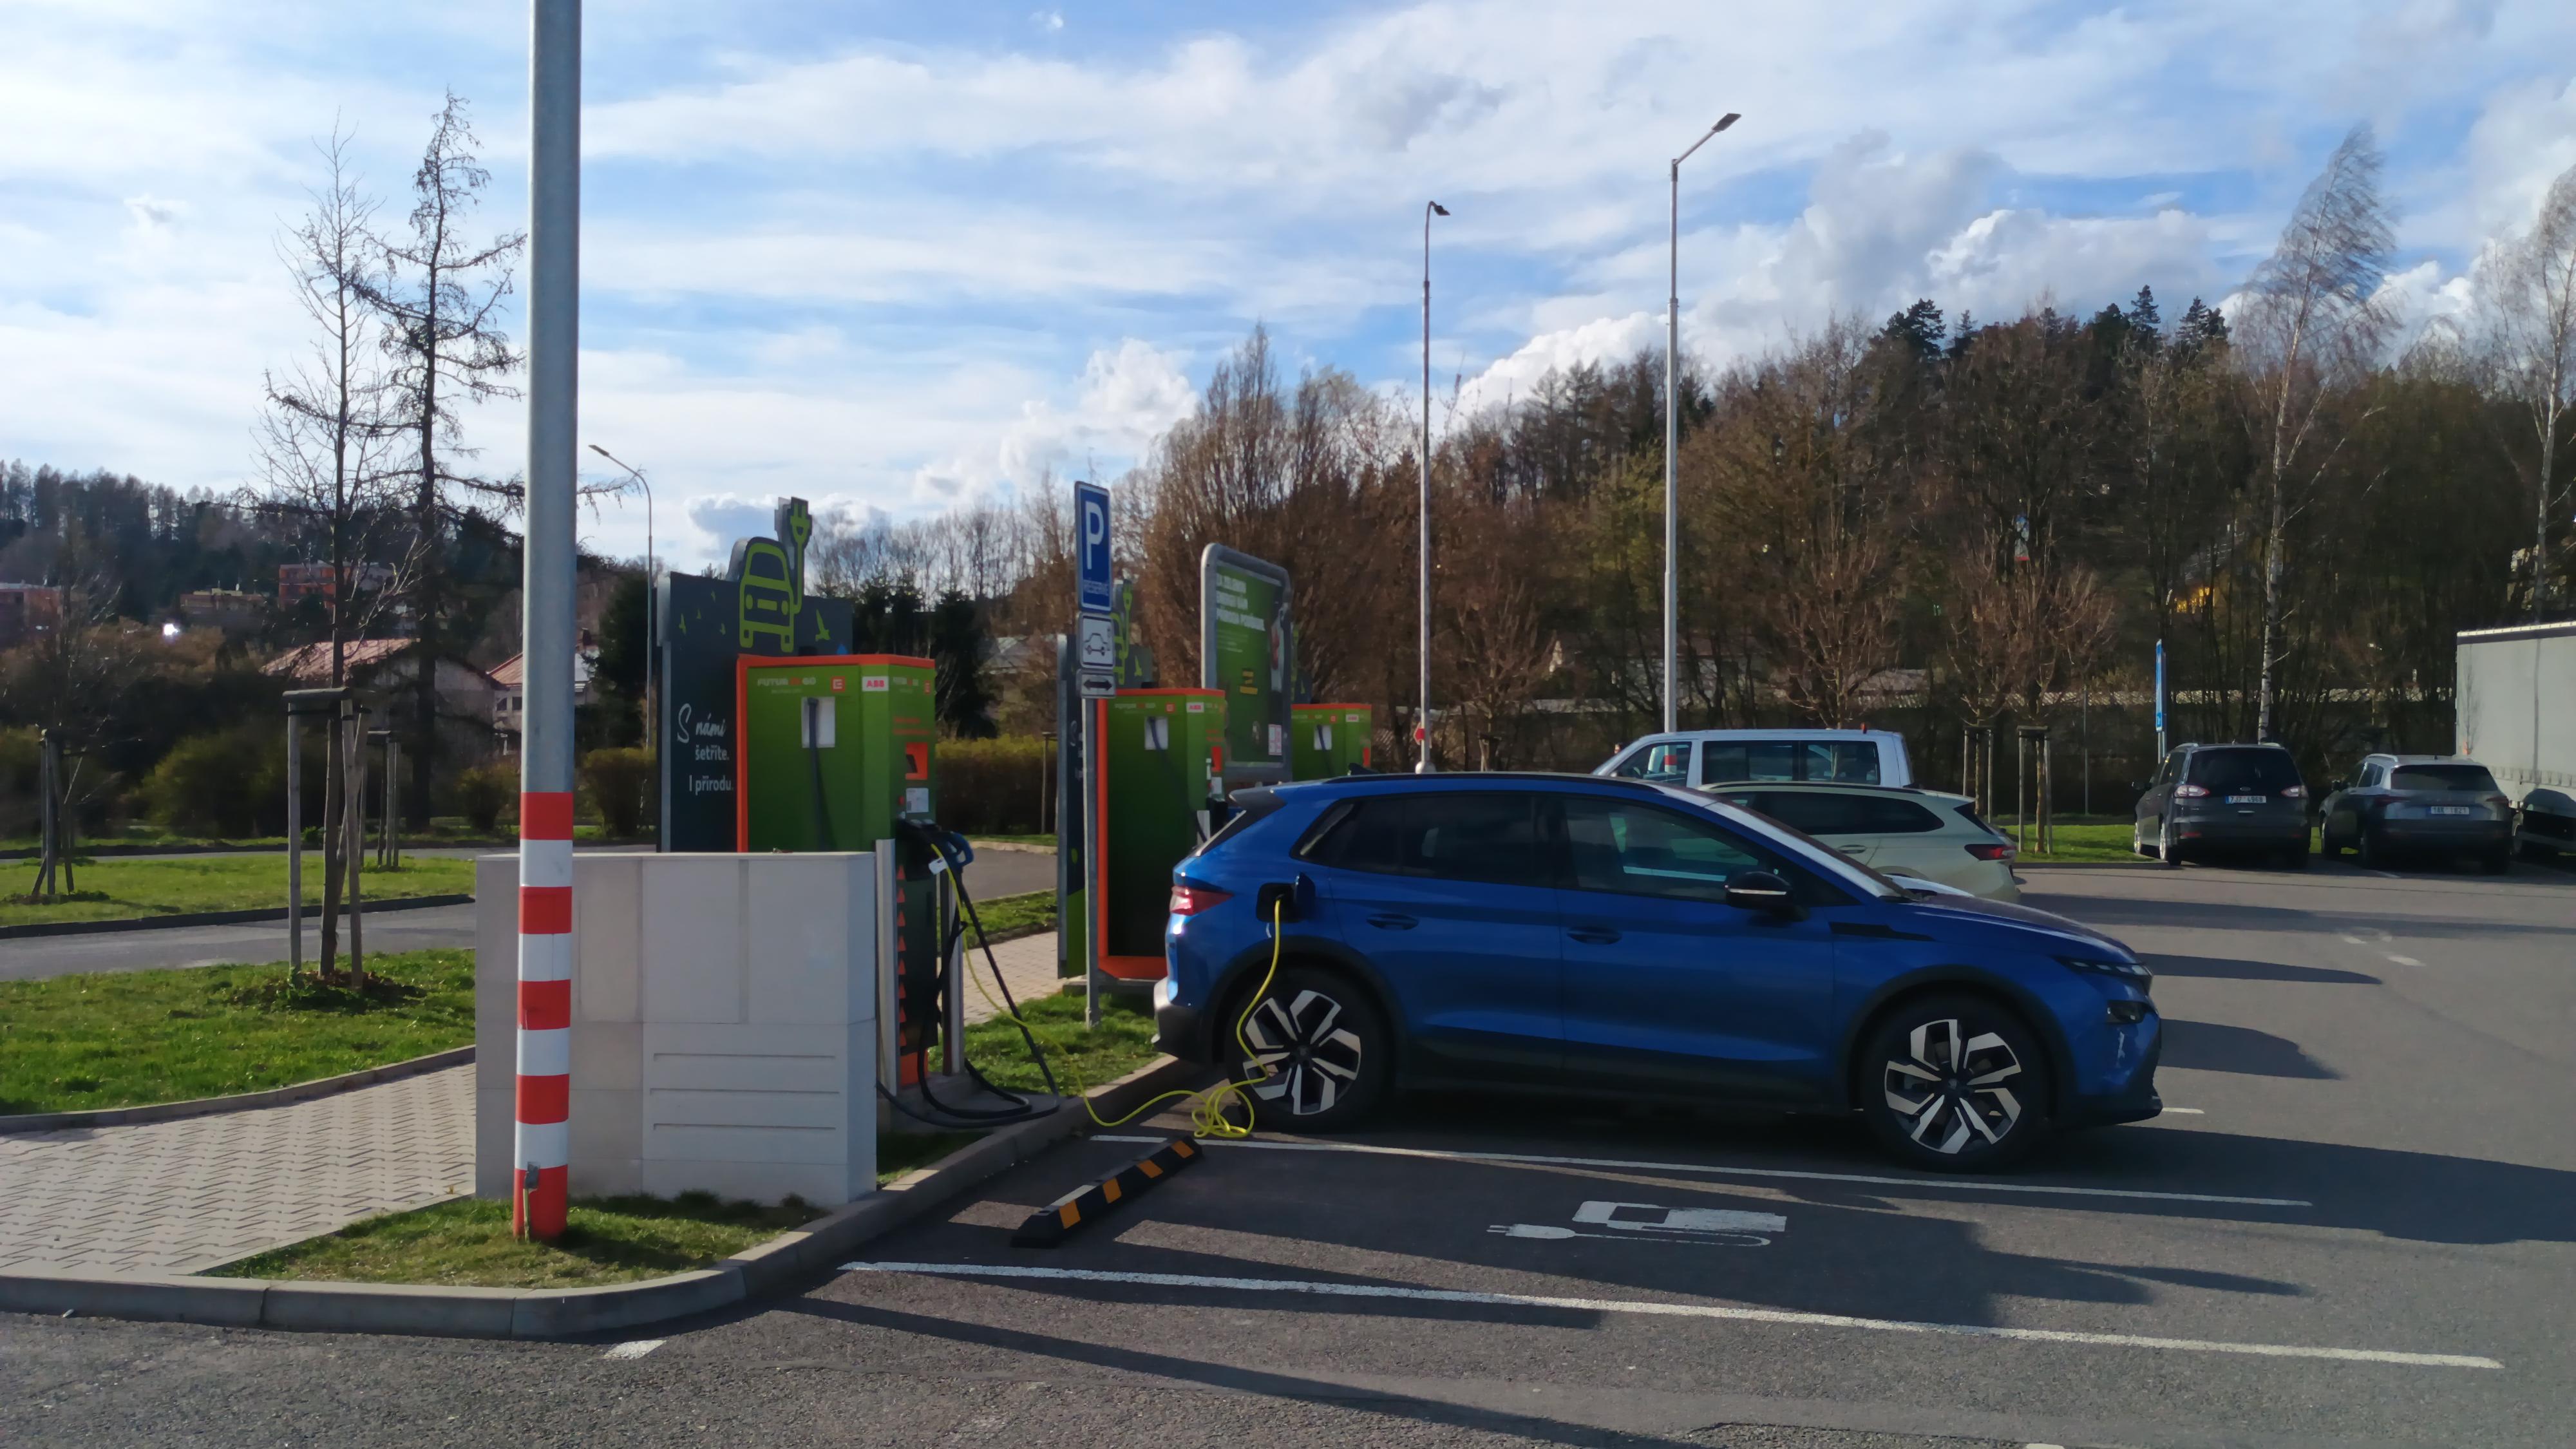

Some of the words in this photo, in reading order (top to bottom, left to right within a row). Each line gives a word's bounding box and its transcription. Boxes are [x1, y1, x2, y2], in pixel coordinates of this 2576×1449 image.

[1085, 500, 1104, 570] P
[866, 679, 886, 688] ABB
[677, 703, 692, 743] S
[696, 713, 726, 737] námi
[695, 744, 730, 761] šetříte.
